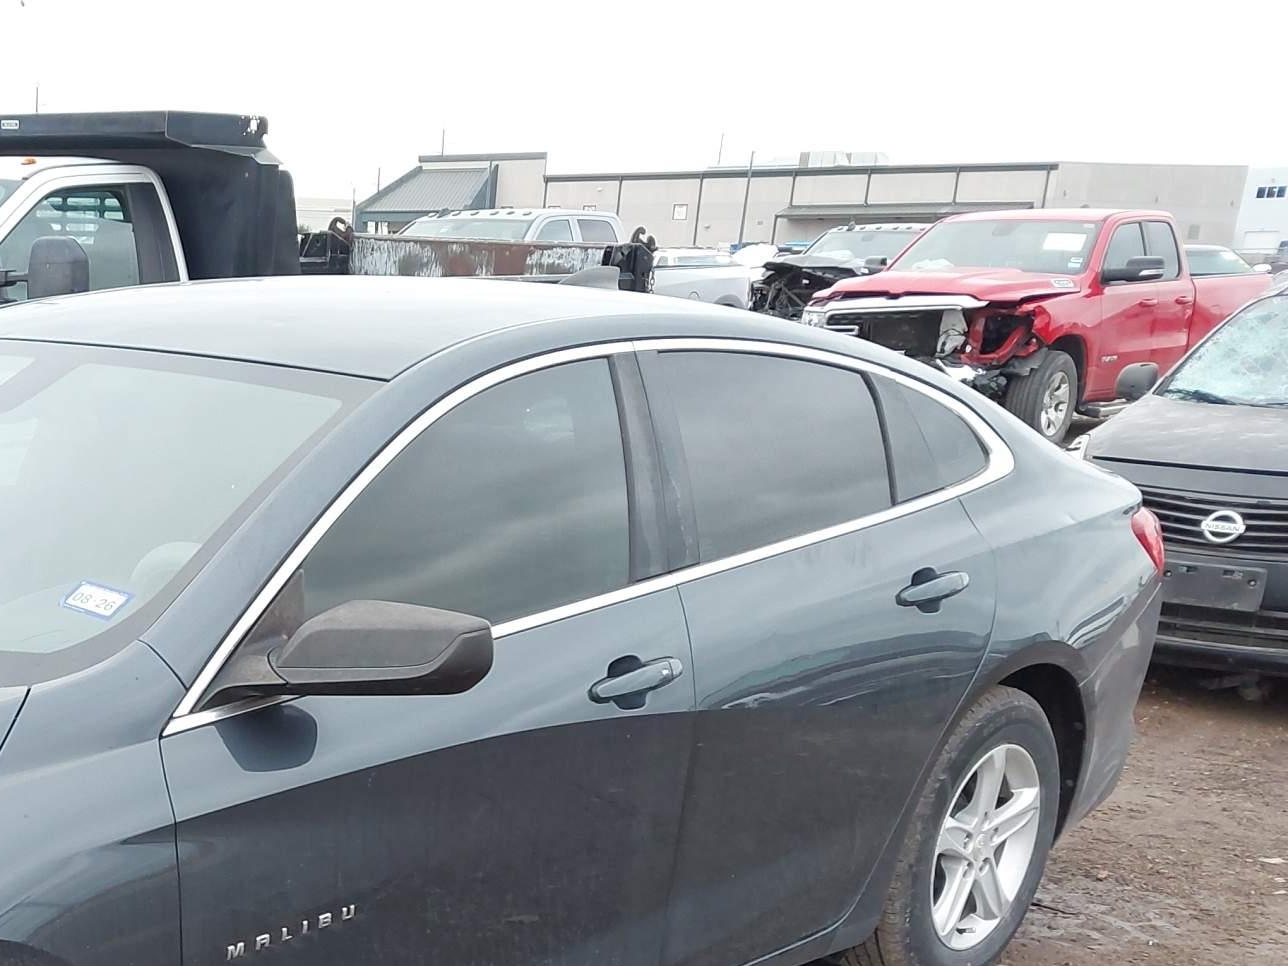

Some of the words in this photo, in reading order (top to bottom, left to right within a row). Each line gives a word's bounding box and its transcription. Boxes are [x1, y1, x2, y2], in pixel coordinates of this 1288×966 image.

[1205, 523, 1240, 532] NISSAN
[72, 593, 93, 604] 08
[96, 599, 116, 611] 26
[226, 904, 357, 961] MALIBU
